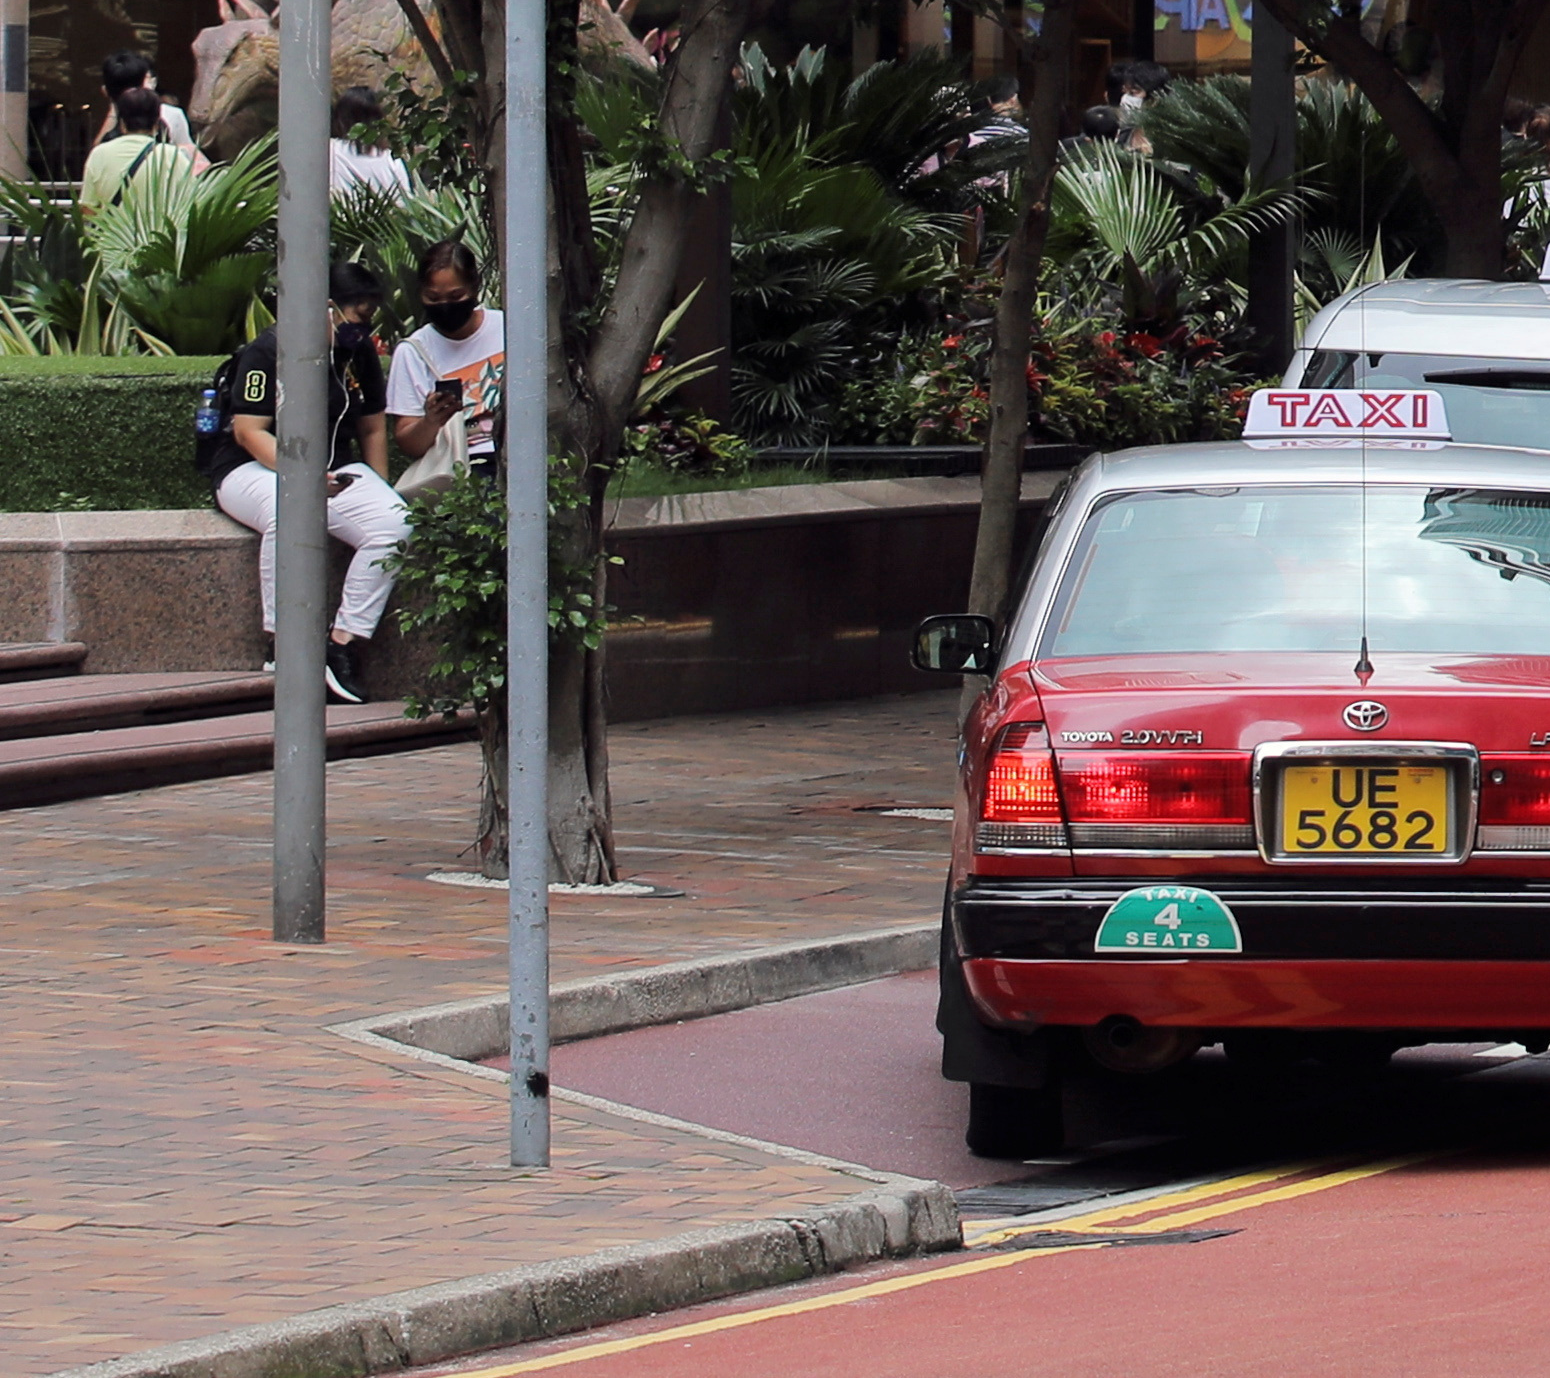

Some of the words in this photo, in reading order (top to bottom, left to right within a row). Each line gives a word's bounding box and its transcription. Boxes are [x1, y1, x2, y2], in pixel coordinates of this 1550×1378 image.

[244, 370, 267, 402] 8
[1267, 392, 1428, 429] TAXI
[1061, 731, 1114, 744] TOYOTA
[1332, 768, 1400, 810] UE
[1295, 809, 1435, 850] 5682
[1141, 886, 1198, 903] TAXI
[1154, 903, 1183, 930] 4
[1124, 931, 1211, 948] SEATS
